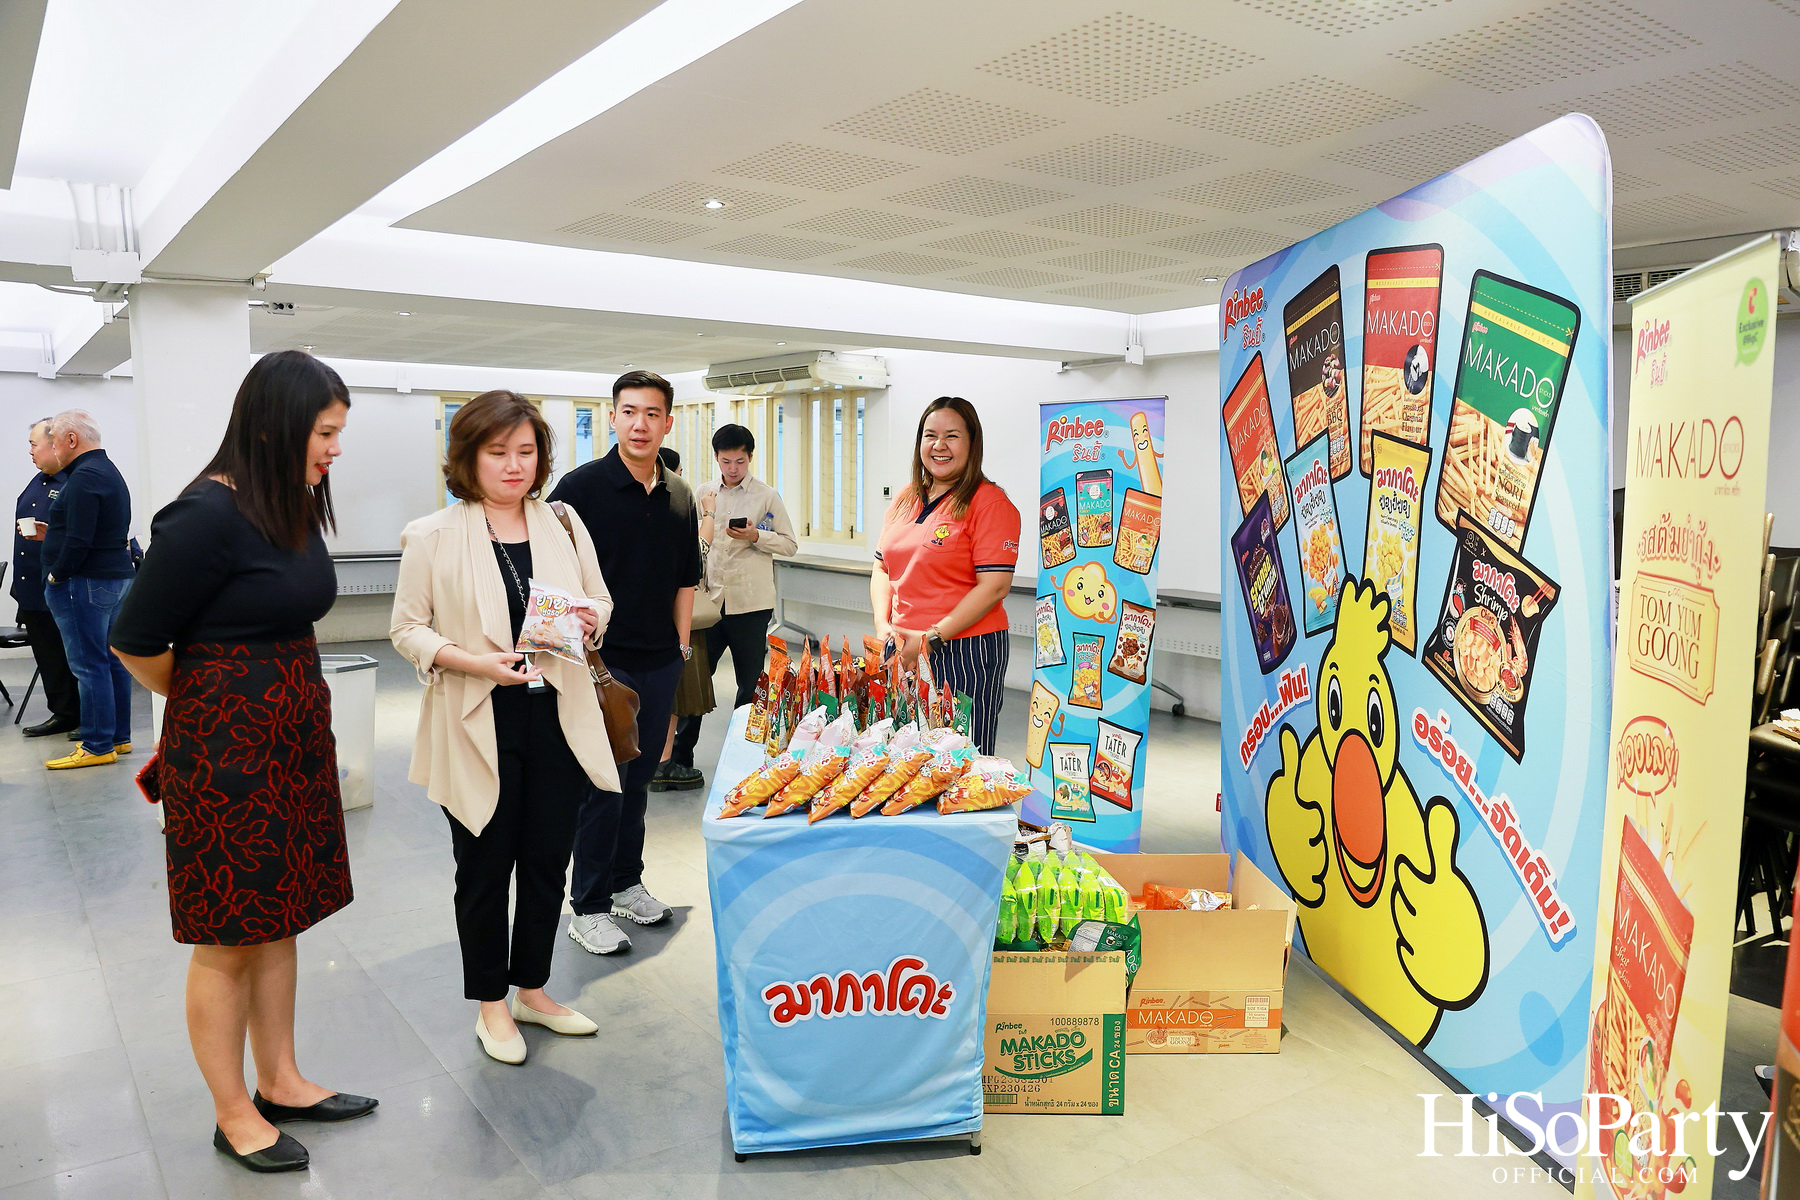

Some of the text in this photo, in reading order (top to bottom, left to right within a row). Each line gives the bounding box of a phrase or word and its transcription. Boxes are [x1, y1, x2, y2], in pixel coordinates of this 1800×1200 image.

[1223, 285, 1264, 342] Rinbee
[1366, 310, 1435, 337] MAKADO
[1289, 321, 1340, 372] MAKADO
[1636, 318, 1670, 374] Rinbee
[1464, 337, 1555, 409] MAKADO
[1046, 416, 1104, 452] Rinbee
[1231, 397, 1268, 457] MAKADO
[1073, 441, 1102, 462] รินบี้
[1636, 415, 1744, 480] MAKADO
[1294, 460, 1328, 503] มากาโดะ
[1377, 467, 1419, 502] มากาโดะ
[1497, 475, 1523, 501] NORI
[1079, 499, 1111, 510] MAKADO
[1123, 508, 1162, 526] MAKADO
[1473, 560, 1519, 613] มากาโดะ
[1474, 584, 1508, 627] Shrimp
[1640, 594, 1702, 641] TOM YUM
[1637, 623, 1700, 679] GOONG
[1105, 735, 1127, 757] TATER
[1060, 757, 1082, 772] TATER
[1616, 892, 1676, 1019] MAKADO
[765, 958, 953, 1024] มากาโดะ
[1140, 997, 1164, 1007] Rinbee
[995, 1022, 1022, 1033] Rinbee
[1050, 1017, 1100, 1026] 100889878
[1138, 1011, 1214, 1025] MAKADO
[1000, 1031, 1086, 1056] MAKADO
[1013, 1049, 1076, 1071] STICKS
[1109, 1050, 1120, 1069] CA
[1109, 1070, 1120, 1107] ขนาด
